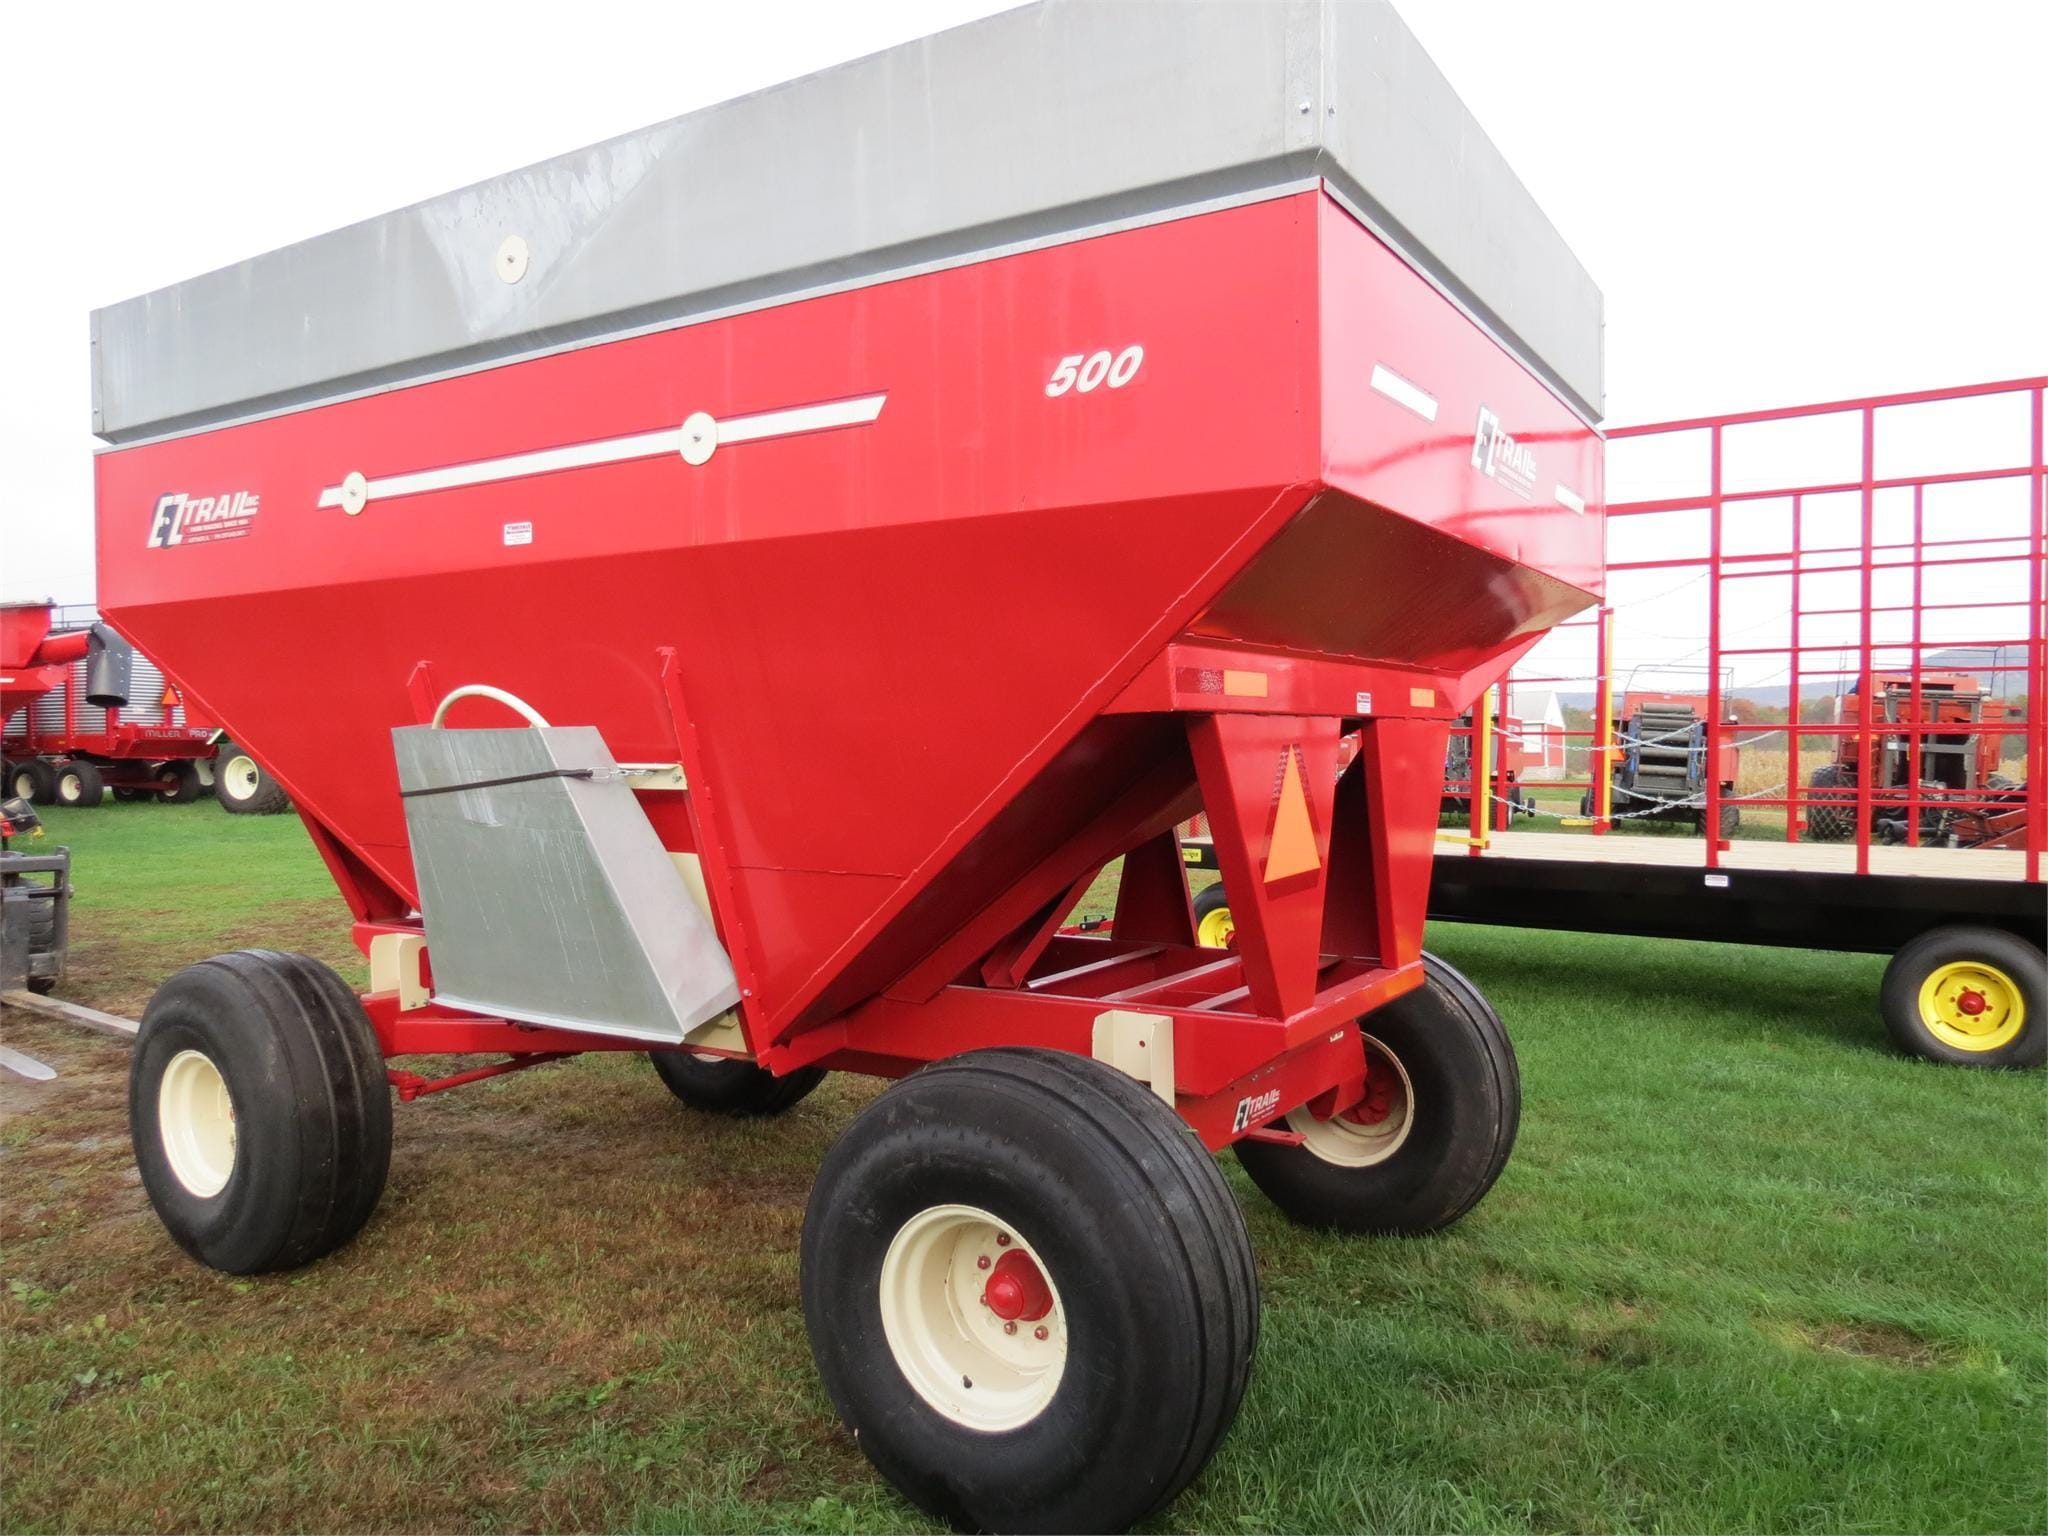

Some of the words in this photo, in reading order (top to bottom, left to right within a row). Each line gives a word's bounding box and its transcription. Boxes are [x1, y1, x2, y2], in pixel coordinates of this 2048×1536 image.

[1044, 345, 1144, 398] 500
[1470, 405, 1499, 478] EZ
[1494, 429, 1537, 482] TRAIL
[146, 492, 190, 549] EZ
[183, 490, 259, 526] TRAIL
[144, 729, 181, 738] MILLER
[189, 729, 208, 738] PRO
[1249, 1088, 1281, 1116] TRAIL
